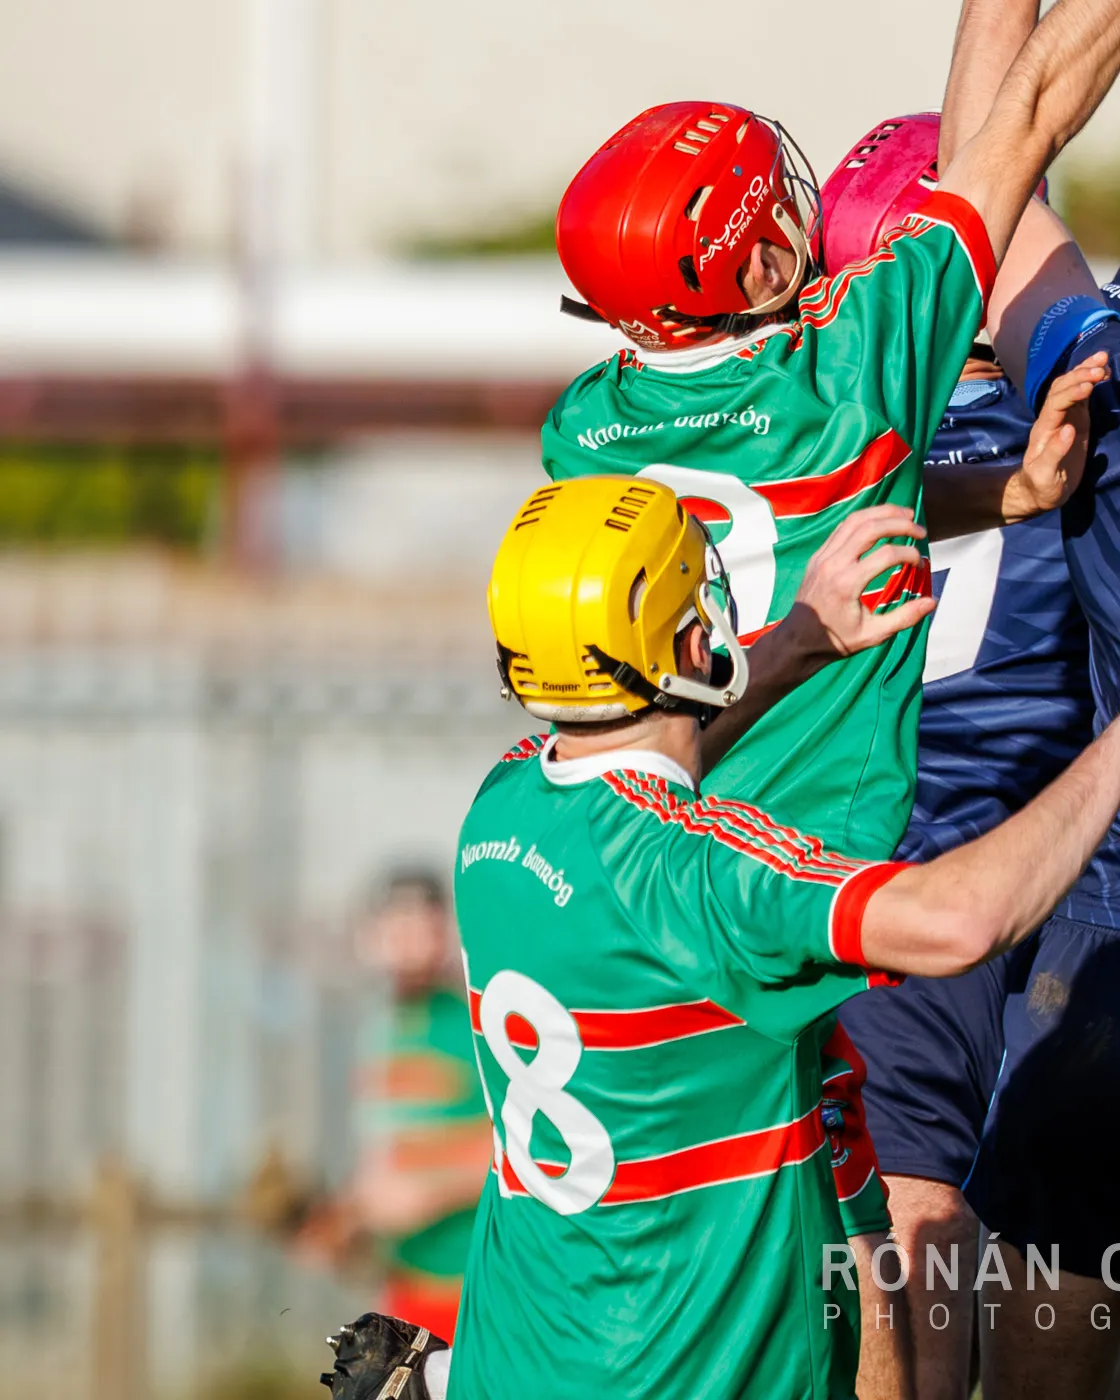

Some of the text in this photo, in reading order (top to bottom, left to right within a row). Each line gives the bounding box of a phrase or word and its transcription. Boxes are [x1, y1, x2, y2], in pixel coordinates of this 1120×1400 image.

[727, 215, 753, 251] XTRA
[461, 835, 522, 874] Naomh
[461, 946, 616, 1216] 8
